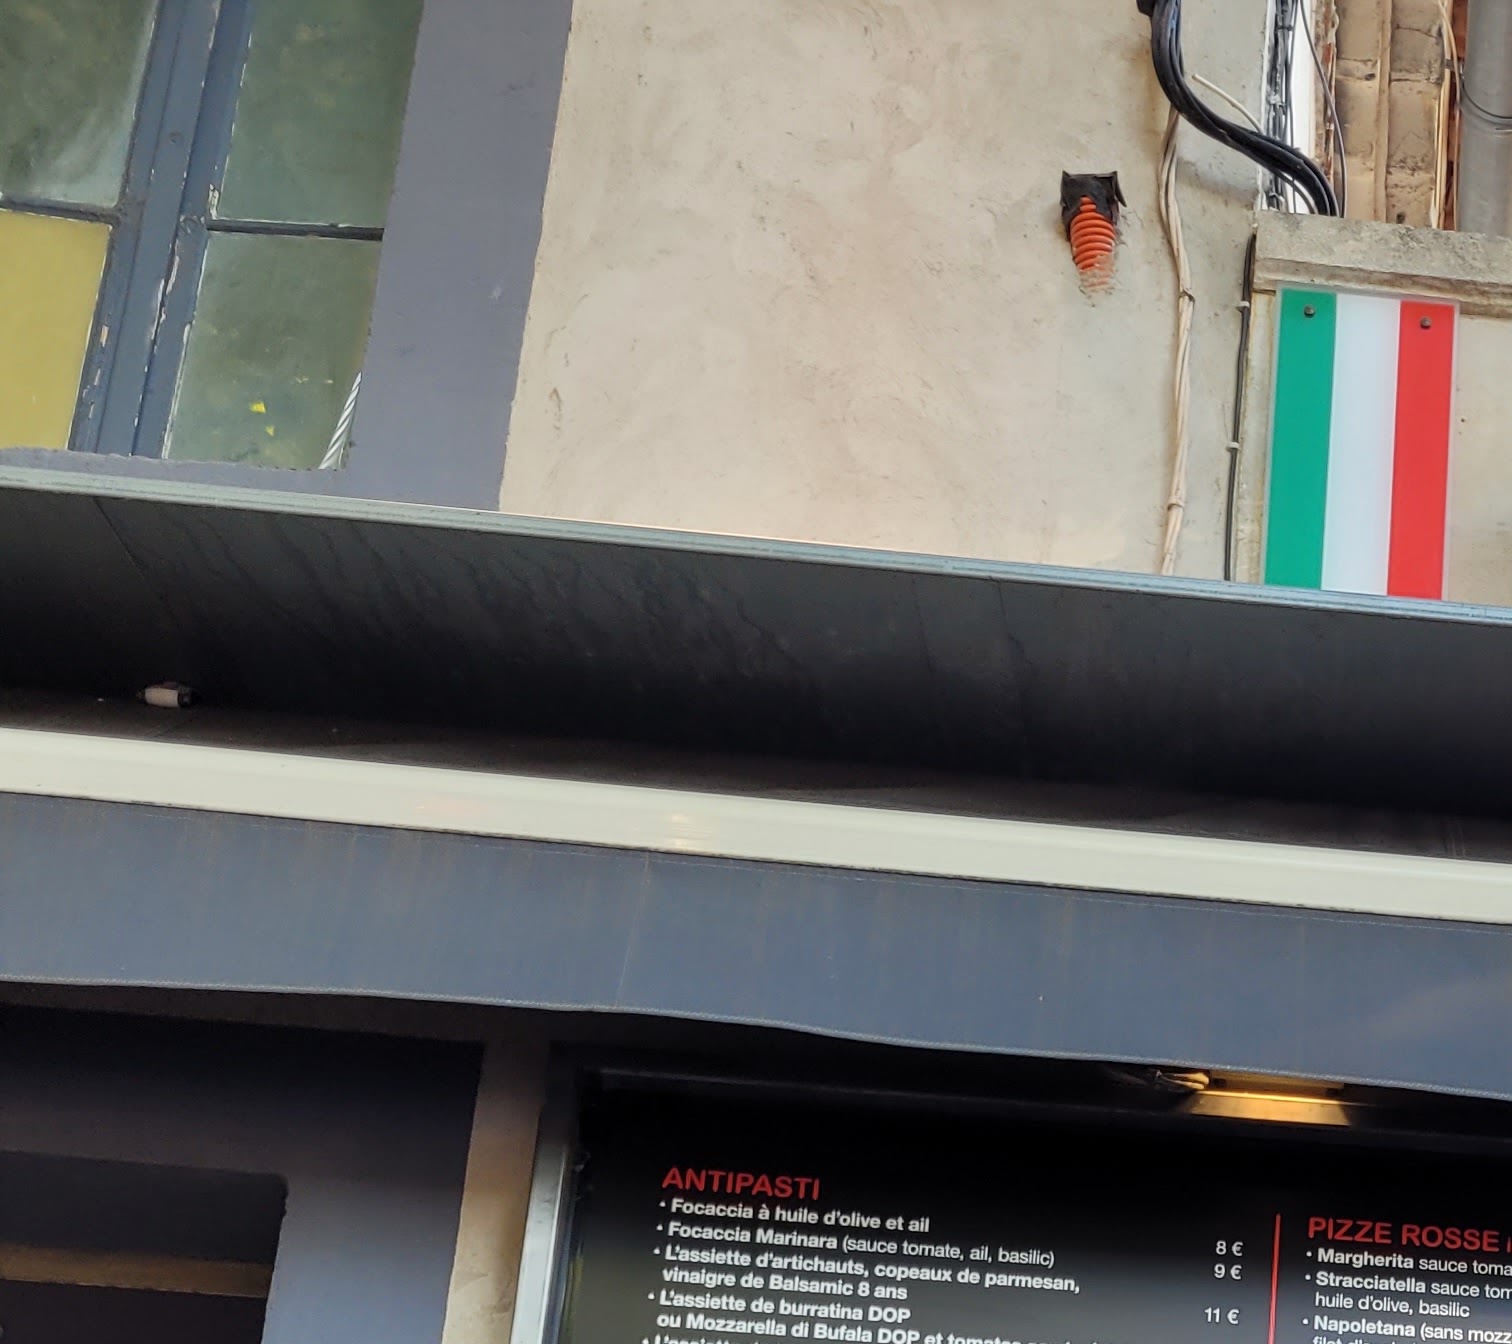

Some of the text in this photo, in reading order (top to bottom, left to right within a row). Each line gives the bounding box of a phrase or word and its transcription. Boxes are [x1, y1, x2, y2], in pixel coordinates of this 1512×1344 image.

[662, 1167, 820, 1200] ANTIPASTI
[1308, 1216, 1392, 1243] PIZZE
[1402, 1224, 1499, 1252] ROSSE
